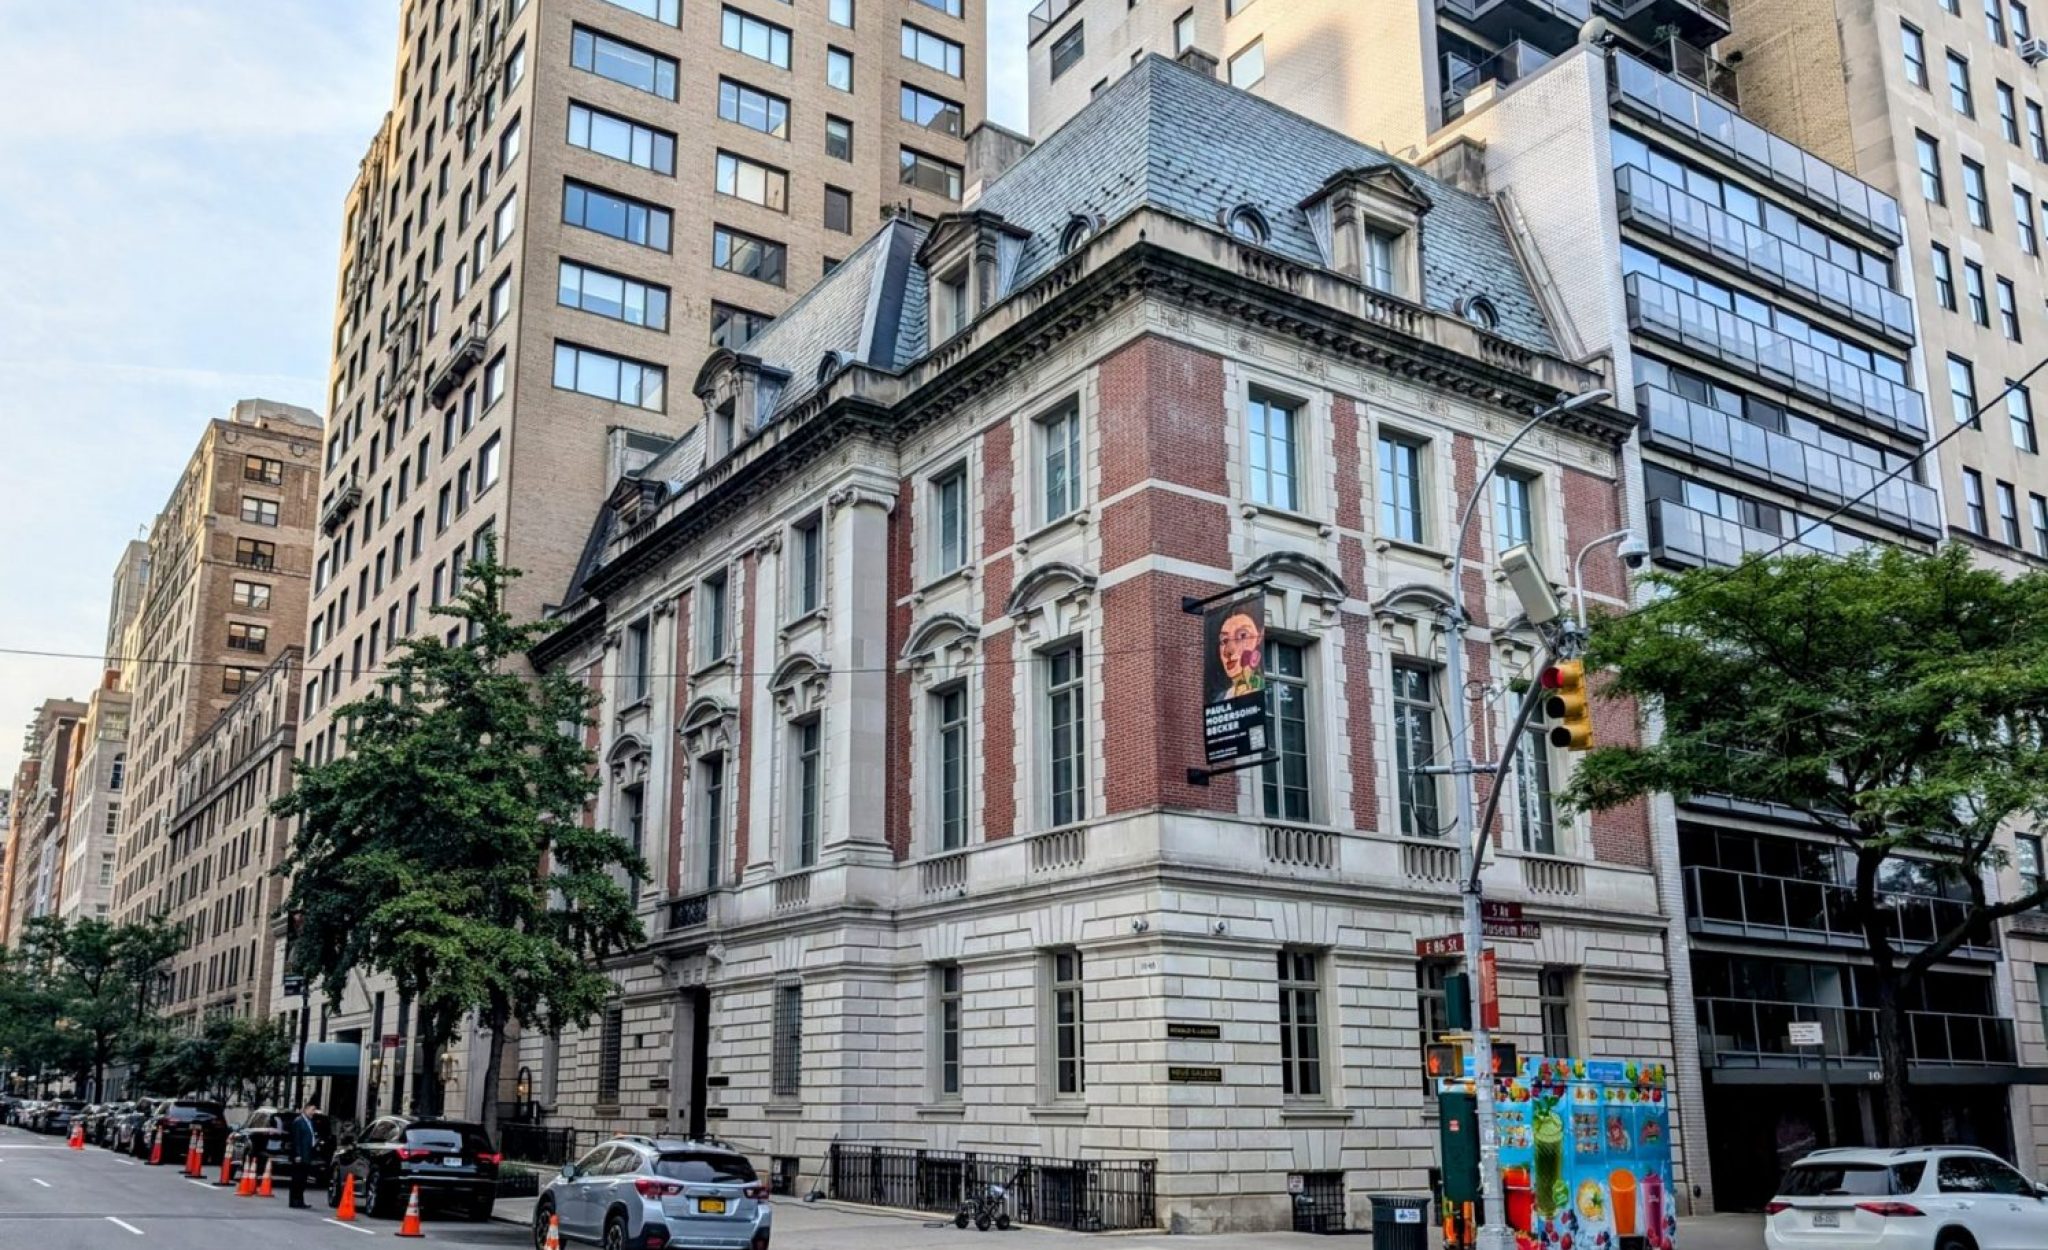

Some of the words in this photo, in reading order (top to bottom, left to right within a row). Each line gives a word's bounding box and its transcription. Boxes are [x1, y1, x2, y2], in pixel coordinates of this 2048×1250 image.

[1205, 703, 1232, 717] PAULA
[1206, 720, 1239, 736] BECKER
[1520, 924, 1540, 938] Mile
[1448, 938, 1458, 951] St
